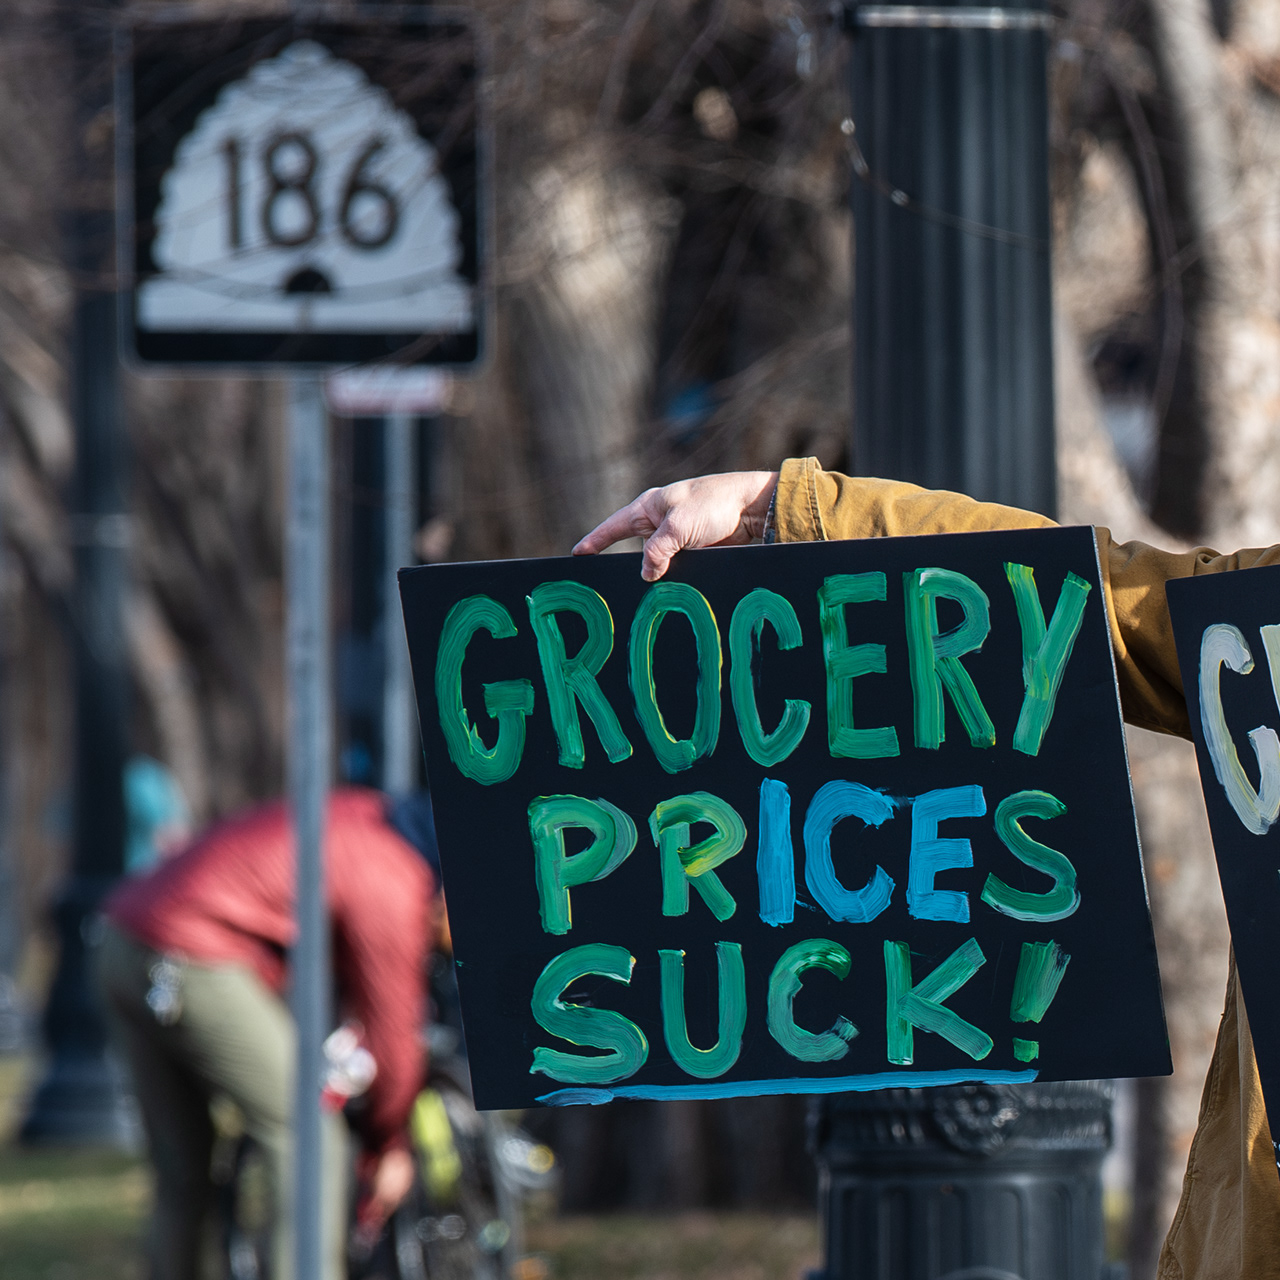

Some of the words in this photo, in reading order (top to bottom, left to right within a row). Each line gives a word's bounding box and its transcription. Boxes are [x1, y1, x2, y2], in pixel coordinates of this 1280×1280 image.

[218, 130, 398, 254] 186
[435, 562, 1092, 785] GROCERY
[528, 777, 1081, 935] PRICES
[529, 937, 1072, 1084] SUCK!
